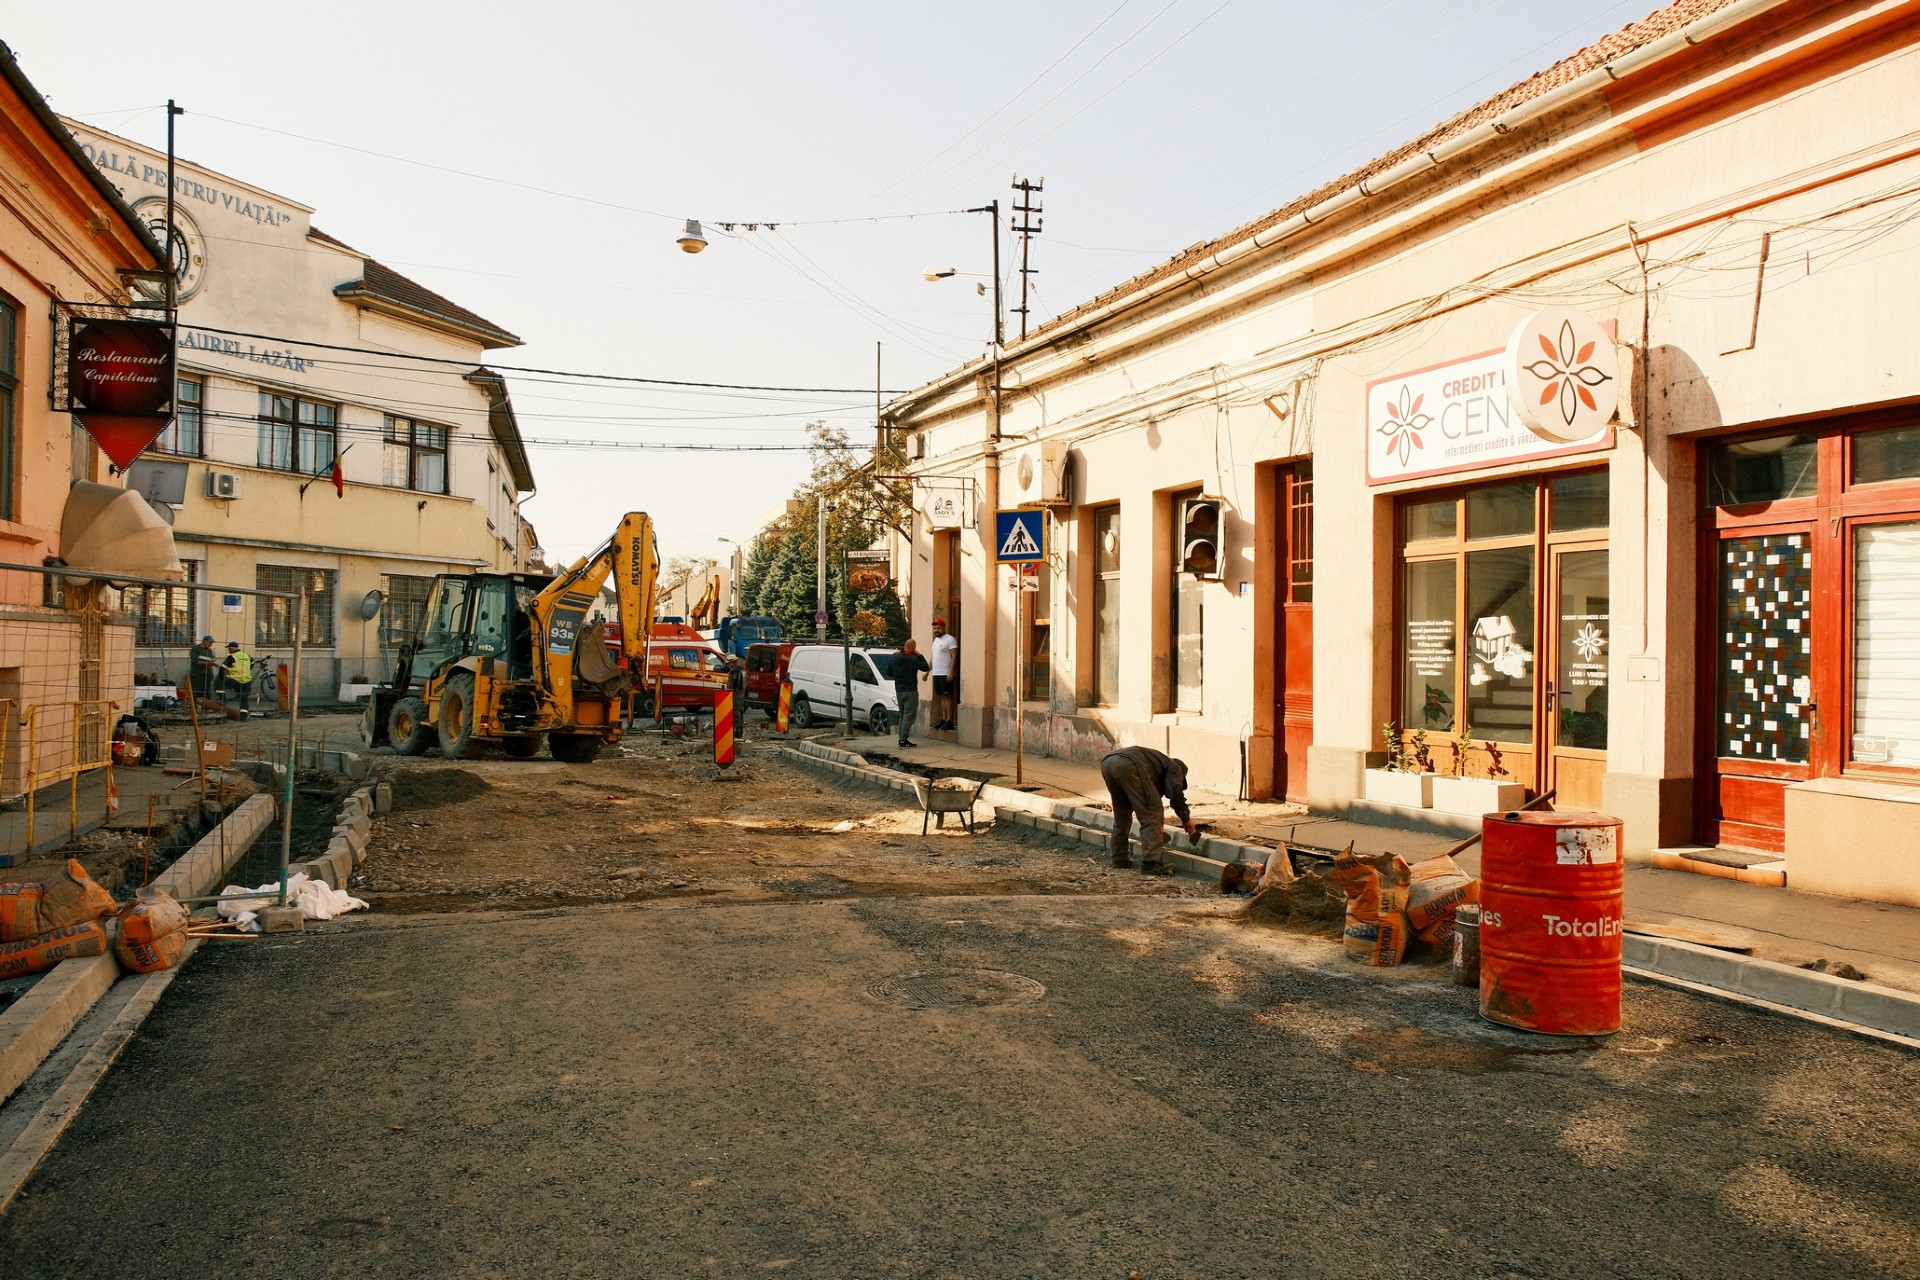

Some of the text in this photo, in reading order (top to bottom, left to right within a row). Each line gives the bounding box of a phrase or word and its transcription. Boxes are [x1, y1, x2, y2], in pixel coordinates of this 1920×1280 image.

[81, 143, 139, 178] OALĂ
[77, 348, 168, 366] Restaurant
[83, 368, 161, 385] Capitolium
[1442, 370, 1497, 399] CREDIT
[1441, 393, 1511, 440] CEN
[1484, 436, 1509, 451] credite
[1510, 434, 1516, 446] &
[1830, 516, 1841, 538] 7
[631, 536, 640, 586] KOMATSU
[551, 627, 575, 640] 93R
[556, 619, 573, 628] WB
[1542, 913, 1622, 938] TotalEn
